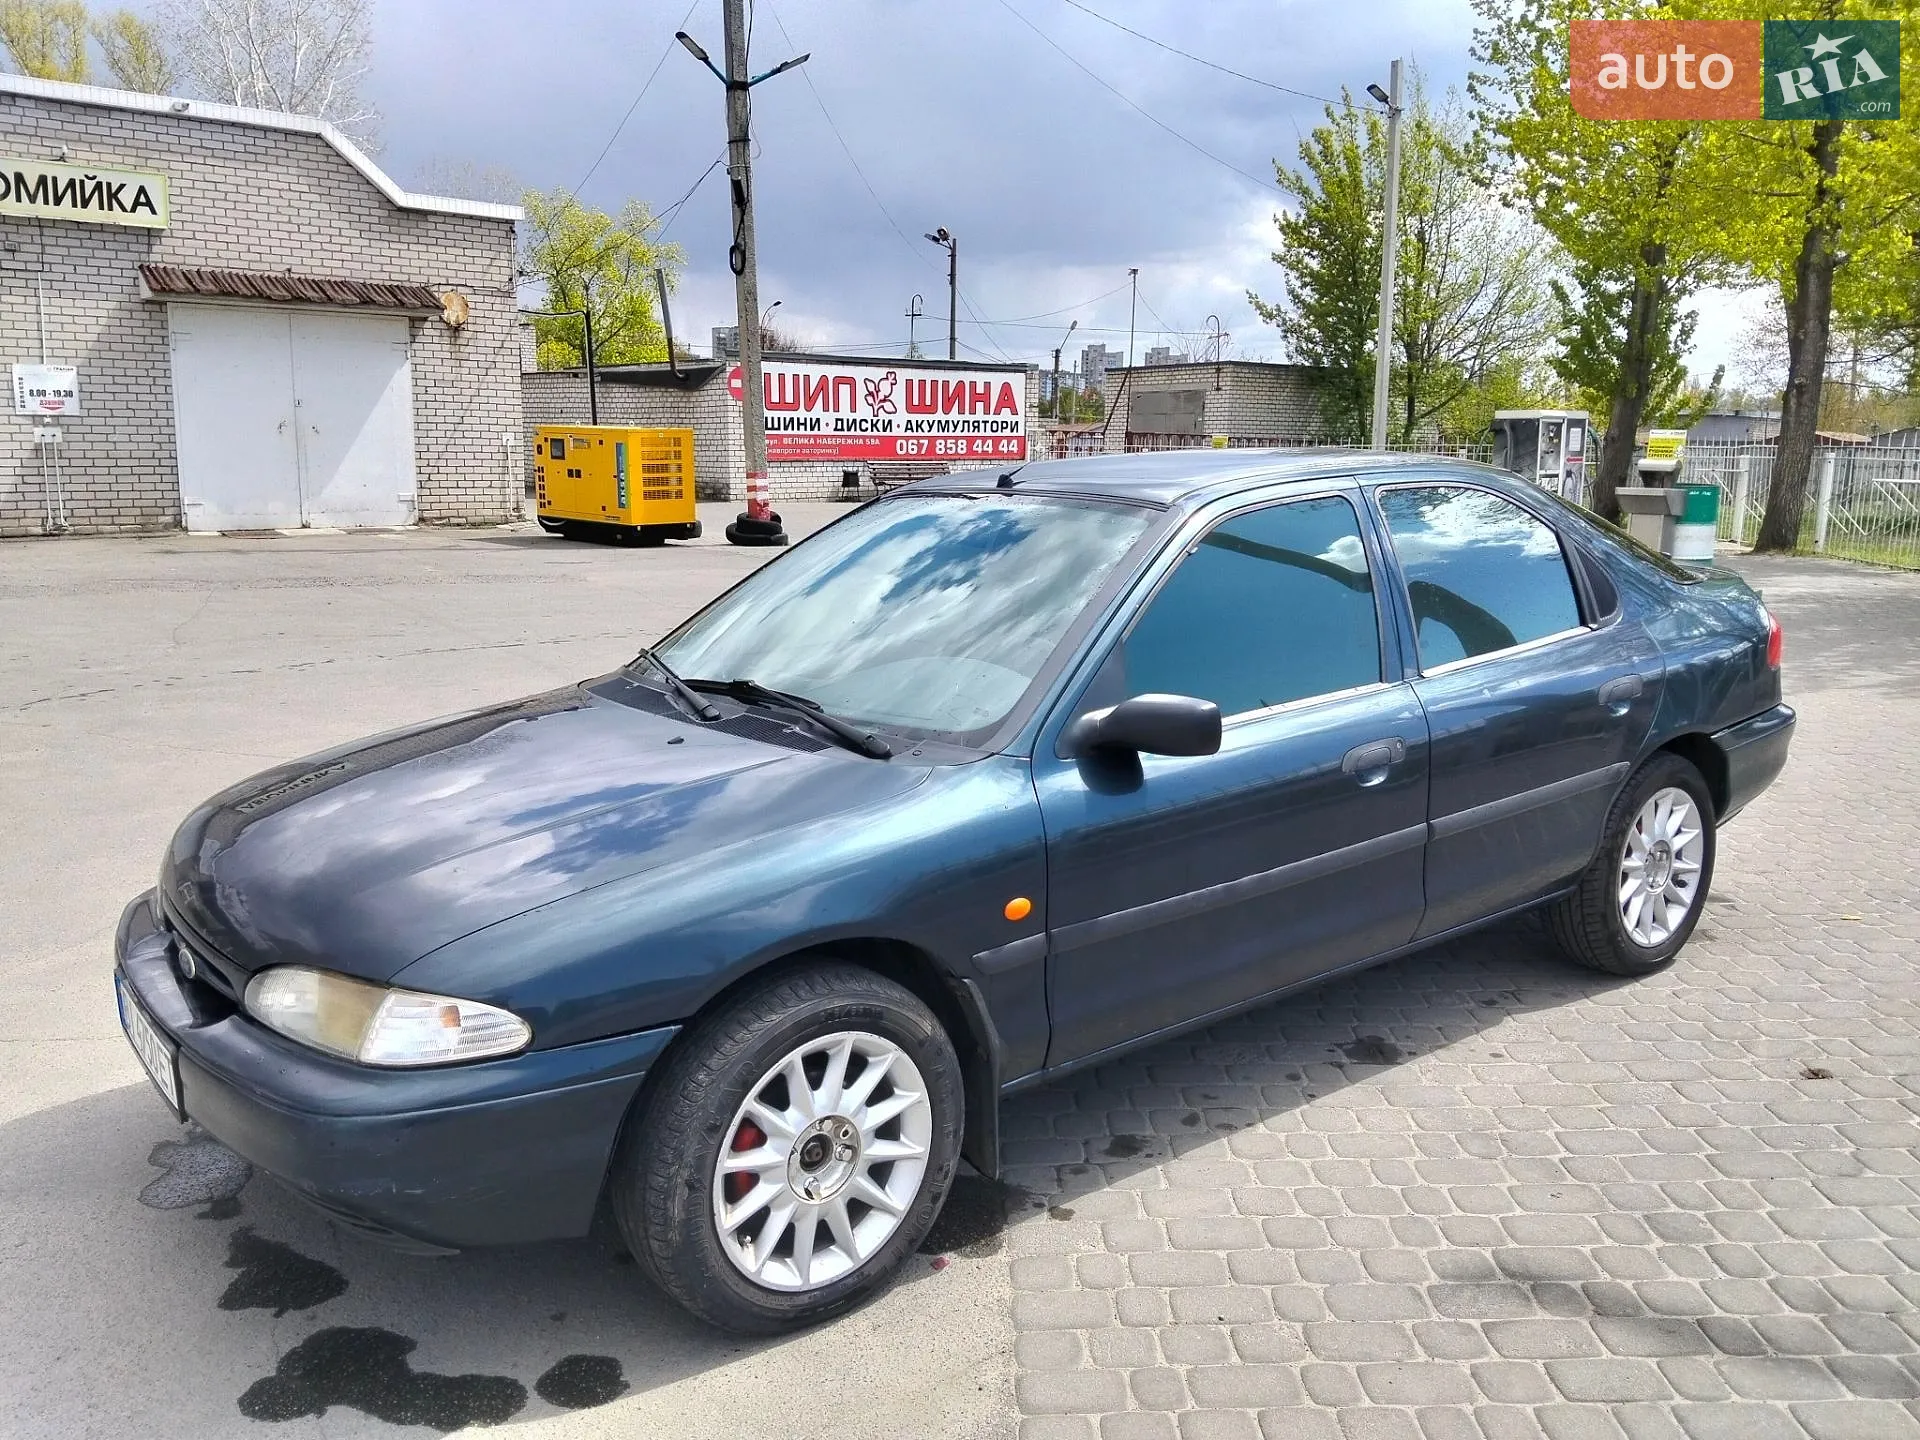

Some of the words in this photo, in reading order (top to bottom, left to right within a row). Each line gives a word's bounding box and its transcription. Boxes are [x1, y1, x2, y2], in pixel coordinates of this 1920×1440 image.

[28, 388, 47, 398] 8.00
[52, 389, 74, 398] 19.30
[763, 372, 857, 413] ШИП
[905, 378, 1019, 415] ШИНА
[764, 416, 821, 432] ШИНИ
[833, 417, 893, 433] ДИСКИ
[904, 419, 1019, 433] АКУМУЛЯТОРИ
[782, 437, 815, 445] ВЕЛИКА
[816, 437, 864, 446] НАБЕРЕЖНА
[895, 439, 929, 455] 067
[935, 439, 968, 455] 858
[972, 439, 994, 454] 44
[998, 439, 1019, 454] 44
